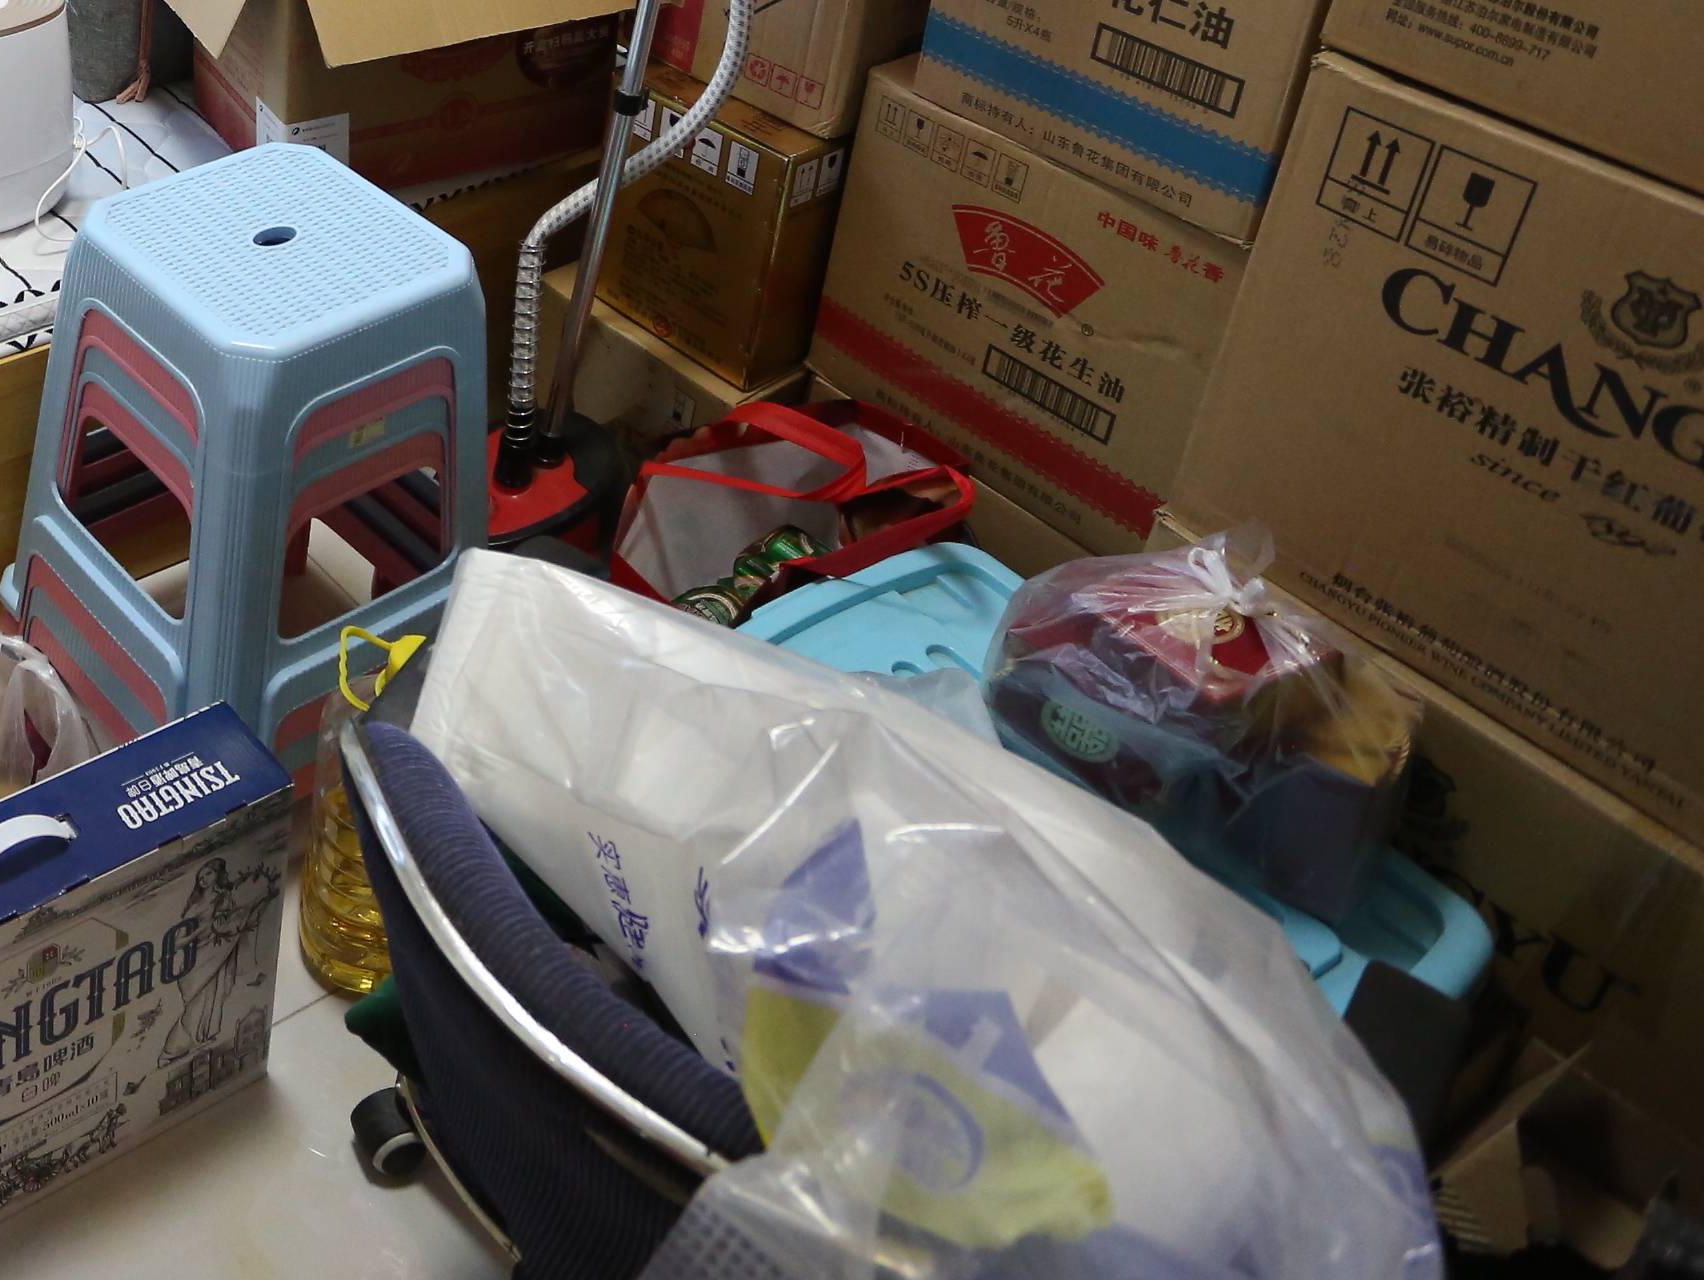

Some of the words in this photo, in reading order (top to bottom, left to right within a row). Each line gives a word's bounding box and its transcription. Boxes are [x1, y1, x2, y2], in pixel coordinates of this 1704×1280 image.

[973, 221, 1072, 304] 鲁花
[1096, 211, 1160, 252] 中国味
[1424, 232, 1484, 272] 易碎物品
[898, 261, 1126, 404] 5S压榨一级花生油
[1397, 366, 1704, 540] 张裕精制干红葡
[1470, 452, 1562, 503] since
[117, 760, 240, 830] TSINGTAO
